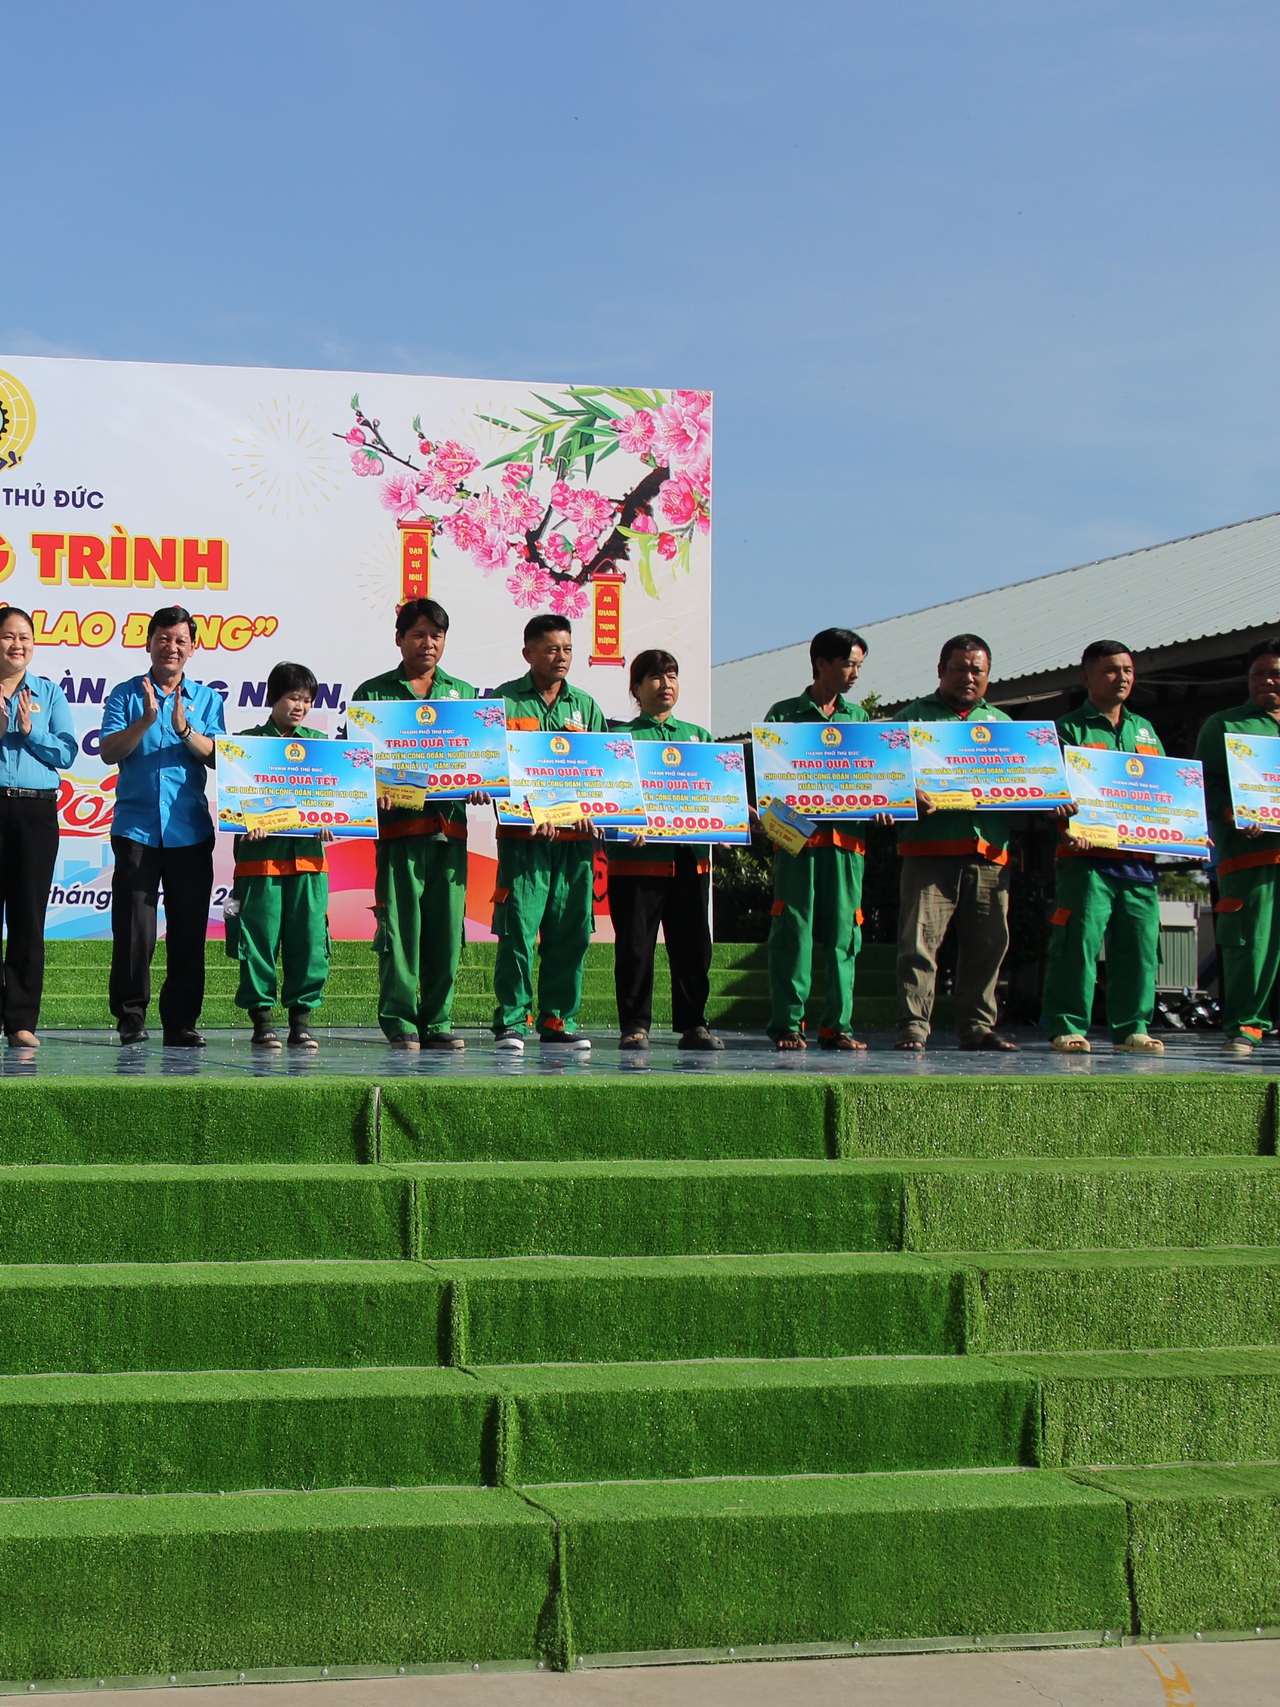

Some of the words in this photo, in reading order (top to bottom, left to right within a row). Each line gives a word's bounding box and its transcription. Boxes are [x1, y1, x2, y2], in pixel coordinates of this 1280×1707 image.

[3, 483, 47, 508] THỦ
[53, 486, 105, 510] ĐỨC
[30, 523, 229, 590] TRÌNH
[31, 610, 117, 648] LAO
[123, 606, 279, 651] ĐNG”
[385, 739, 417, 748] TRAO
[419, 737, 444, 748] QUÀ
[446, 734, 470, 746] TẾT
[791, 760, 823, 768] TRAO
[825, 758, 850, 769] QUÀ
[852, 756, 875, 768] TẾT
[944, 756, 976, 764] TRAO
[977, 755, 1003, 764] QUÀ
[1003, 752, 1027, 763] TẾT
[524, 767, 555, 776] TRAO
[556, 766, 580, 777] QUÀ
[581, 765, 604, 776] TẾT
[253, 774, 285, 783] TRAO
[288, 774, 312, 786] QUÀ
[315, 773, 338, 785] TẾT
[666, 779, 689, 791] QUÀ
[690, 778, 712, 790] TẾT
[971, 786, 1044, 798] 0.000Đ
[1099, 787, 1127, 798] TRAO
[1129, 789, 1151, 802] QUÀ
[1152, 790, 1173, 803] TẾT
[784, 794, 887, 806] 800.000Đ
[1117, 821, 1183, 842] 0.000Đ
[49, 884, 112, 910] tháng
